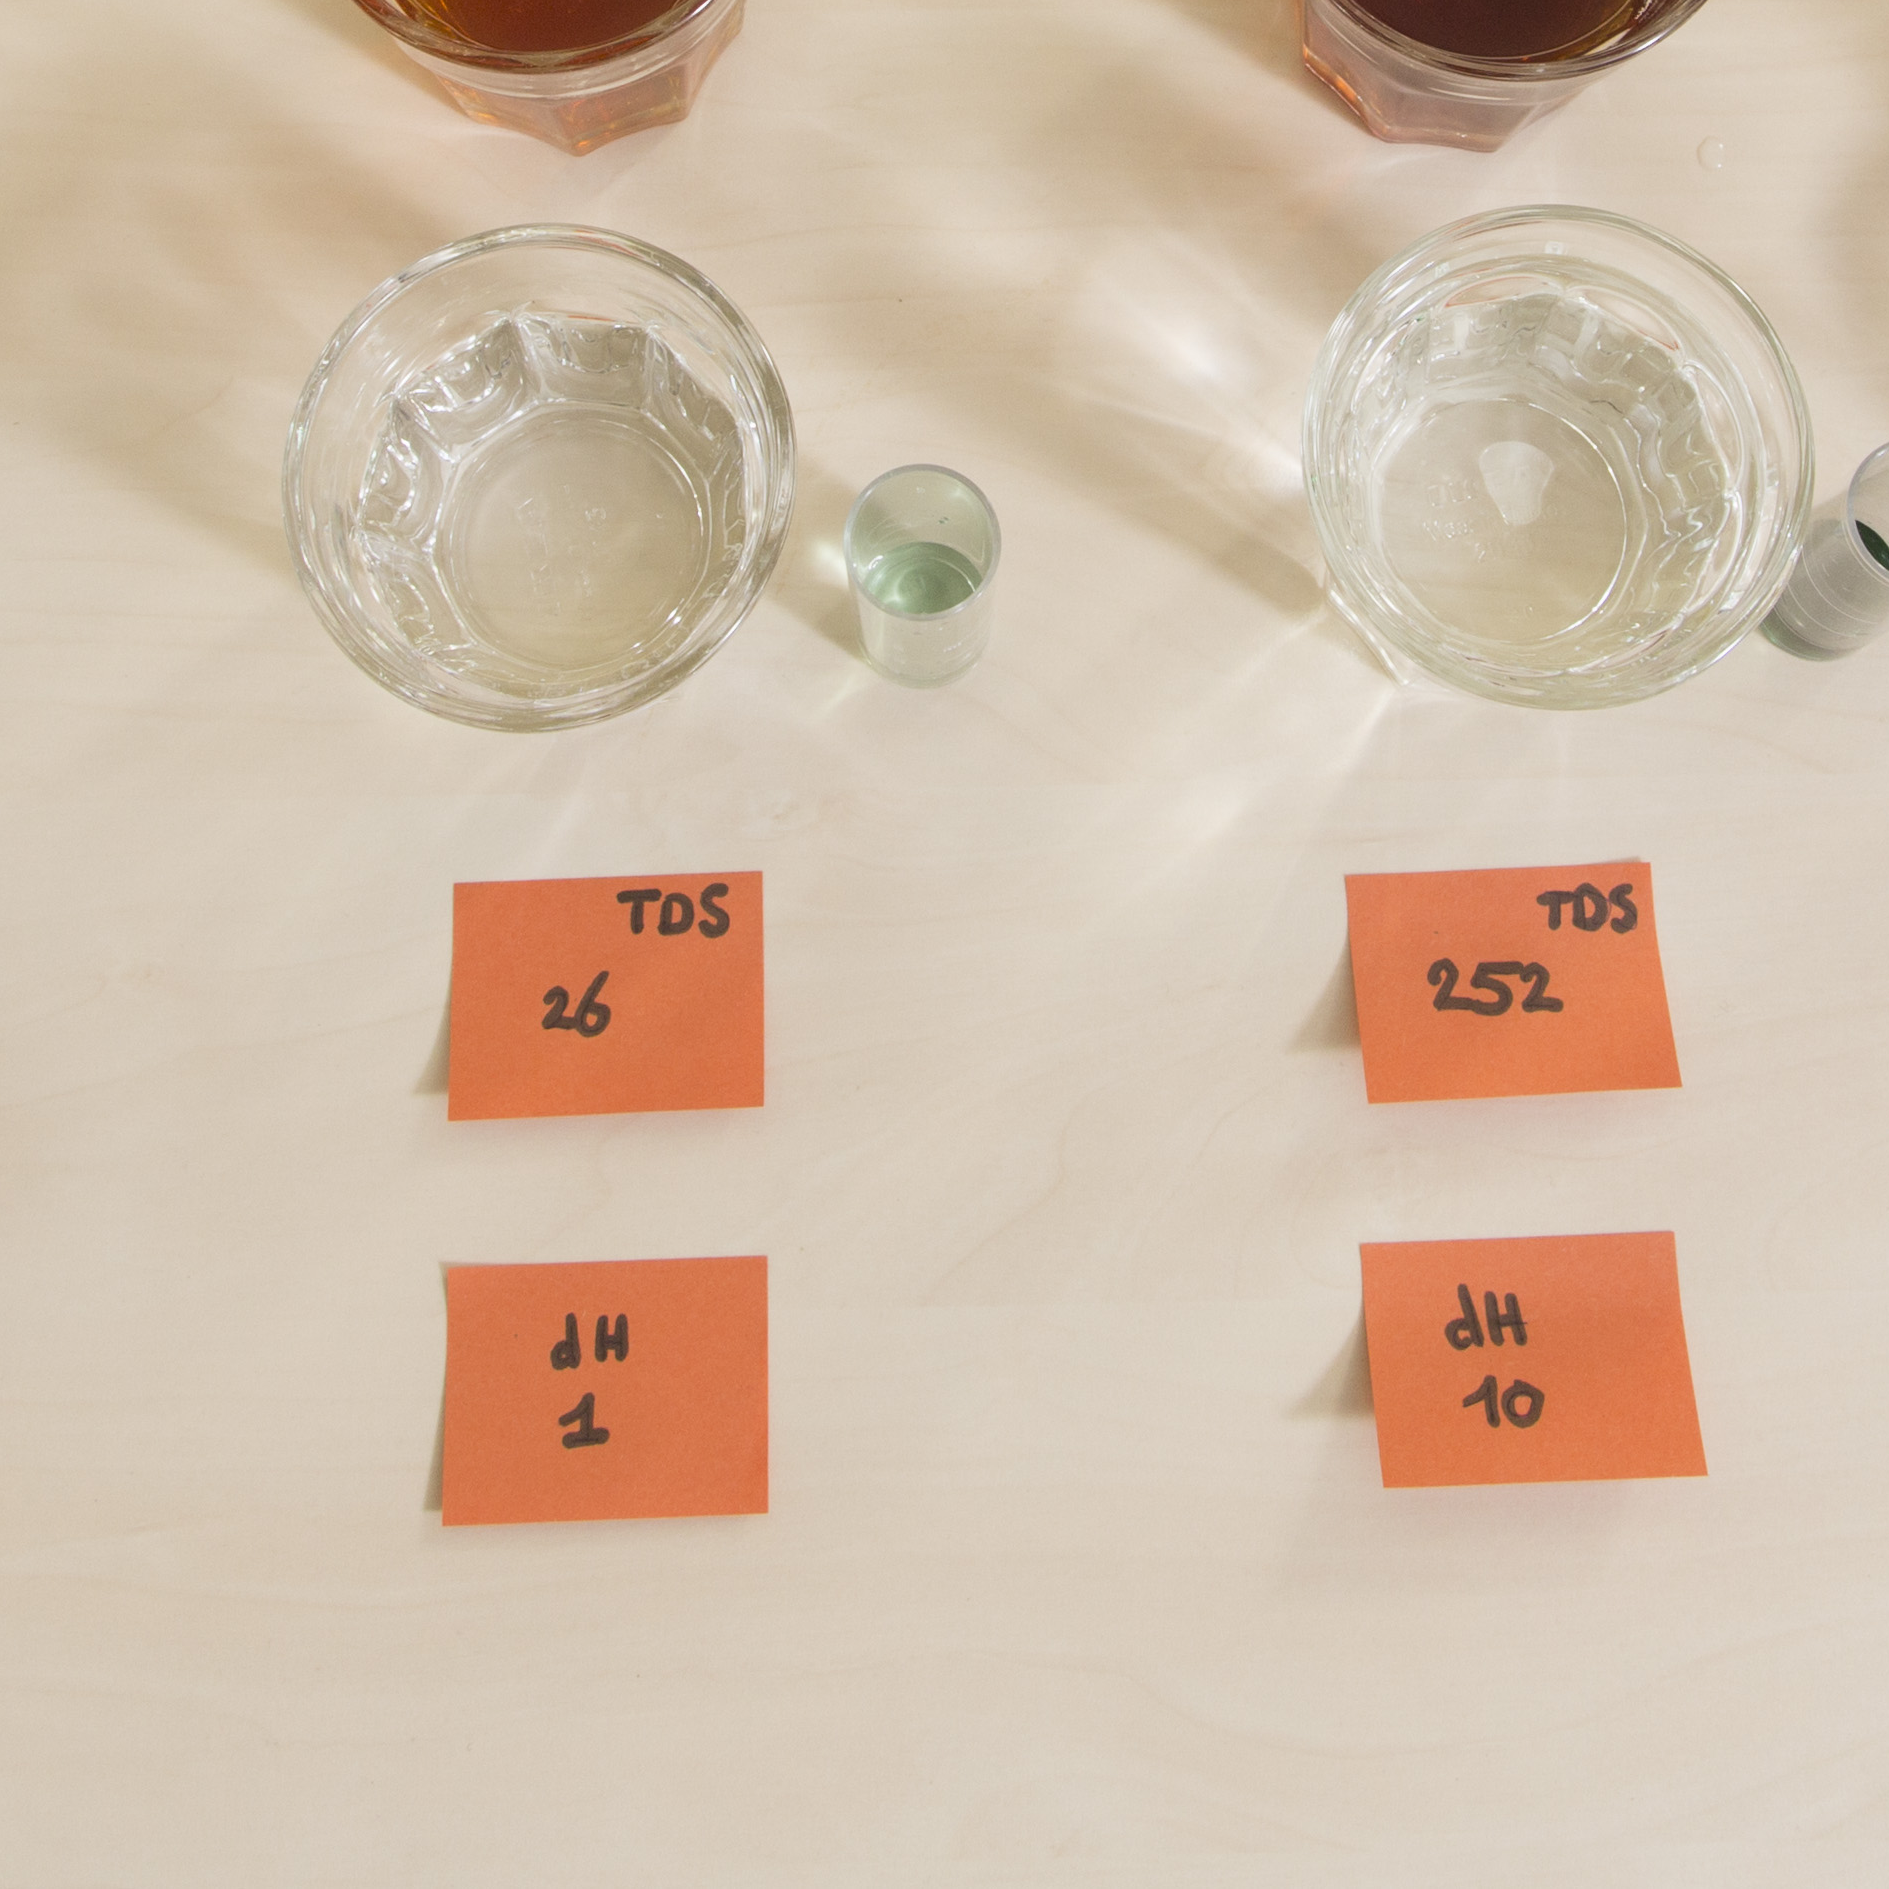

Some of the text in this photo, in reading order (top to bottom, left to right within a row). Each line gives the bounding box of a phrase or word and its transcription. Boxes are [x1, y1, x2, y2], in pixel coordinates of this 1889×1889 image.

[616, 882, 730, 939] TDS
[1536, 882, 1638, 934] TDS
[541, 970, 612, 1038] 26
[1427, 957, 1564, 1017] 252
[549, 1312, 630, 1371] dH
[1444, 1284, 1528, 1351] dH
[558, 1392, 610, 1450] 1
[1462, 1375, 1545, 1429] 10
